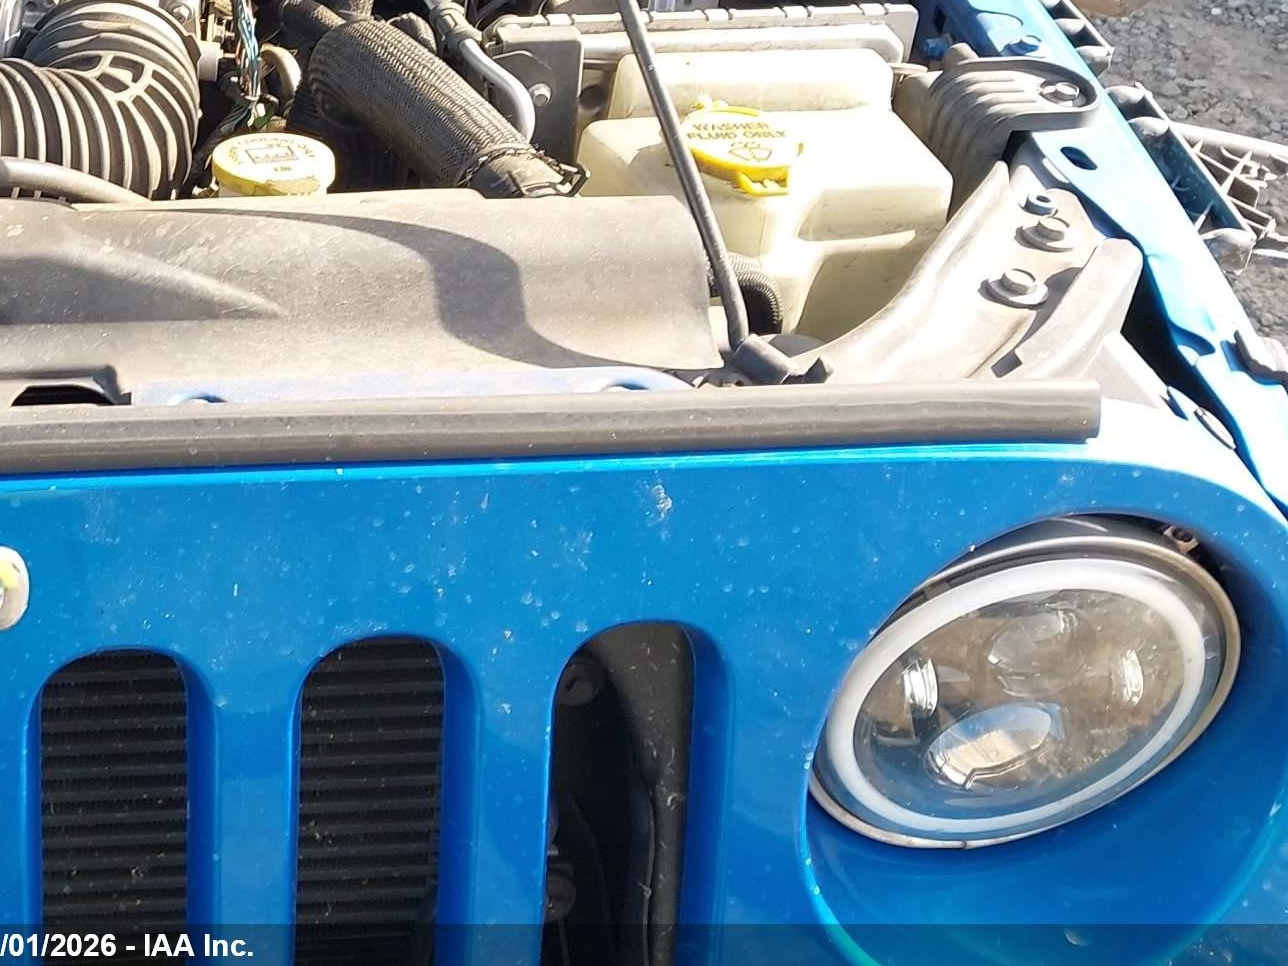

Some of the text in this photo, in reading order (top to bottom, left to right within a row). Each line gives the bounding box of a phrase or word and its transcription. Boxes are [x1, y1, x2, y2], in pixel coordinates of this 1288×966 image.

[692, 121, 770, 131] WASHER
[686, 130, 786, 139] FLUID ONLY
